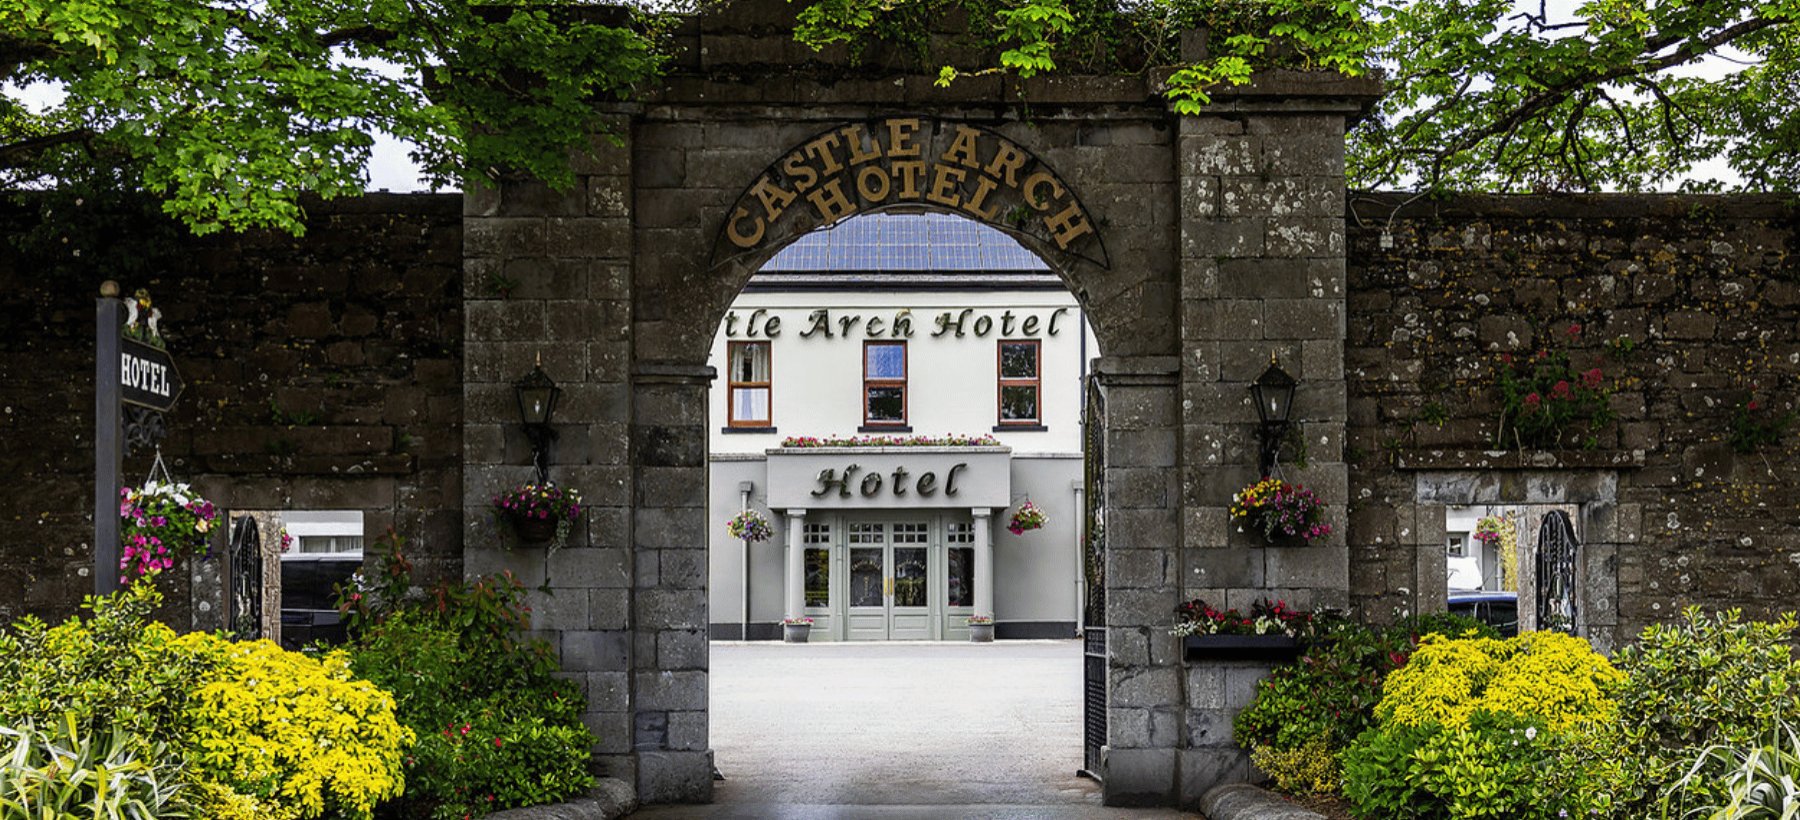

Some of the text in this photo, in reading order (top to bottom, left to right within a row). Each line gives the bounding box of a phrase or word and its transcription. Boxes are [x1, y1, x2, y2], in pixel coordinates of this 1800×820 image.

[727, 118, 1093, 250] CASTLE ARCH
[807, 160, 999, 226] HOTEL
[725, 308, 1067, 338] tle Arch Hotel
[121, 352, 170, 397] HOTEL
[811, 463, 968, 498] Hotel
